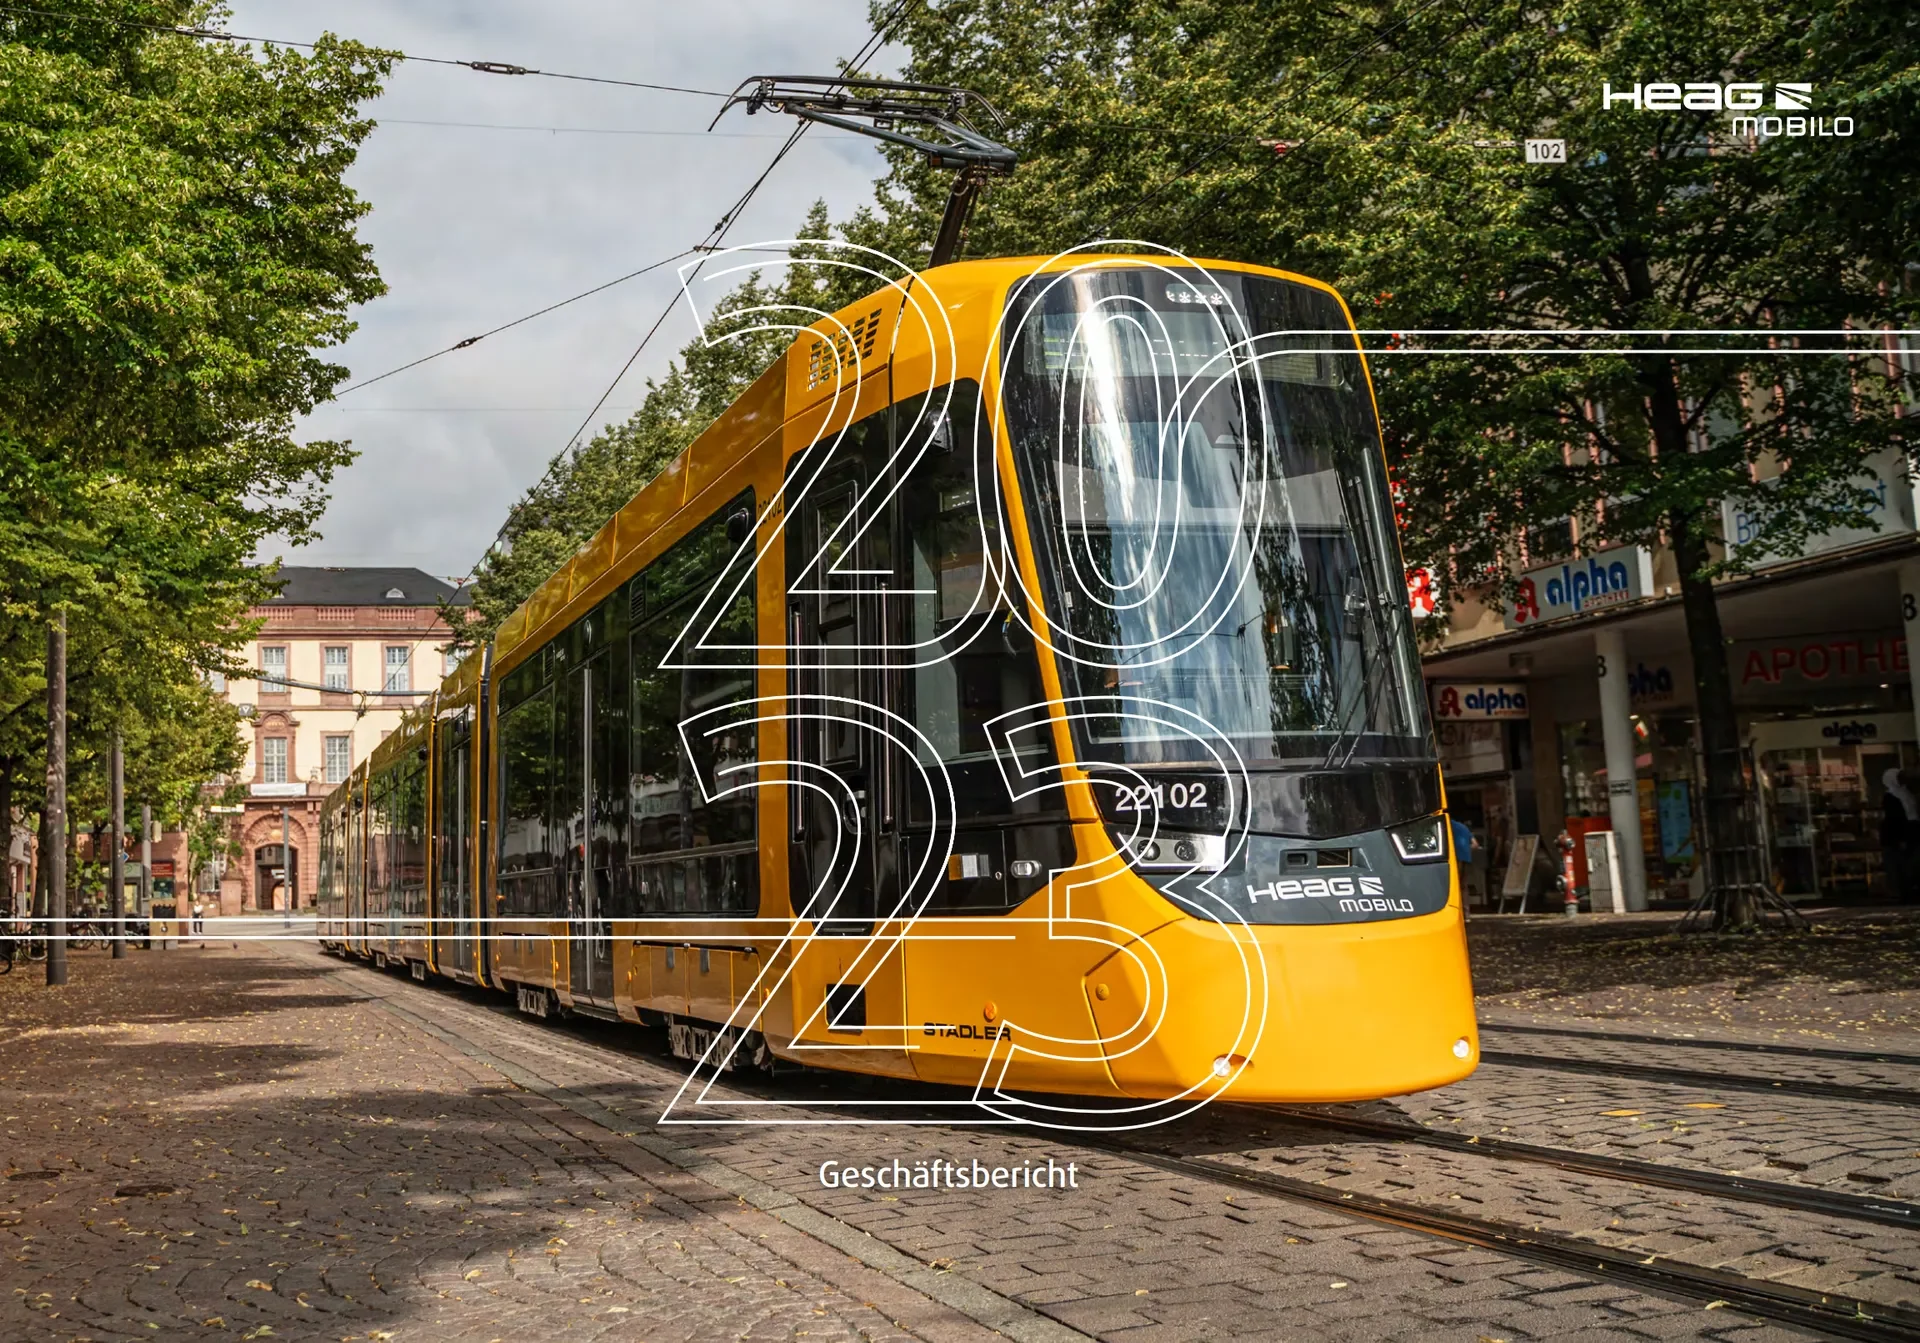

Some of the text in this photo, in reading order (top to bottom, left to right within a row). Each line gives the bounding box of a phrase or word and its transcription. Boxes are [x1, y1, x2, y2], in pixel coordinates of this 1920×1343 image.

[1531, 143, 1561, 159] 102
[1545, 558, 1628, 612] alpha
[1902, 593, 1917, 621] 8
[1464, 687, 1527, 716] alpha
[1822, 719, 1878, 744] alpha
[1115, 782, 1207, 812] 22102
[1339, 899, 1414, 913] MOBILO
[924, 1022, 1011, 1041] STADLER
